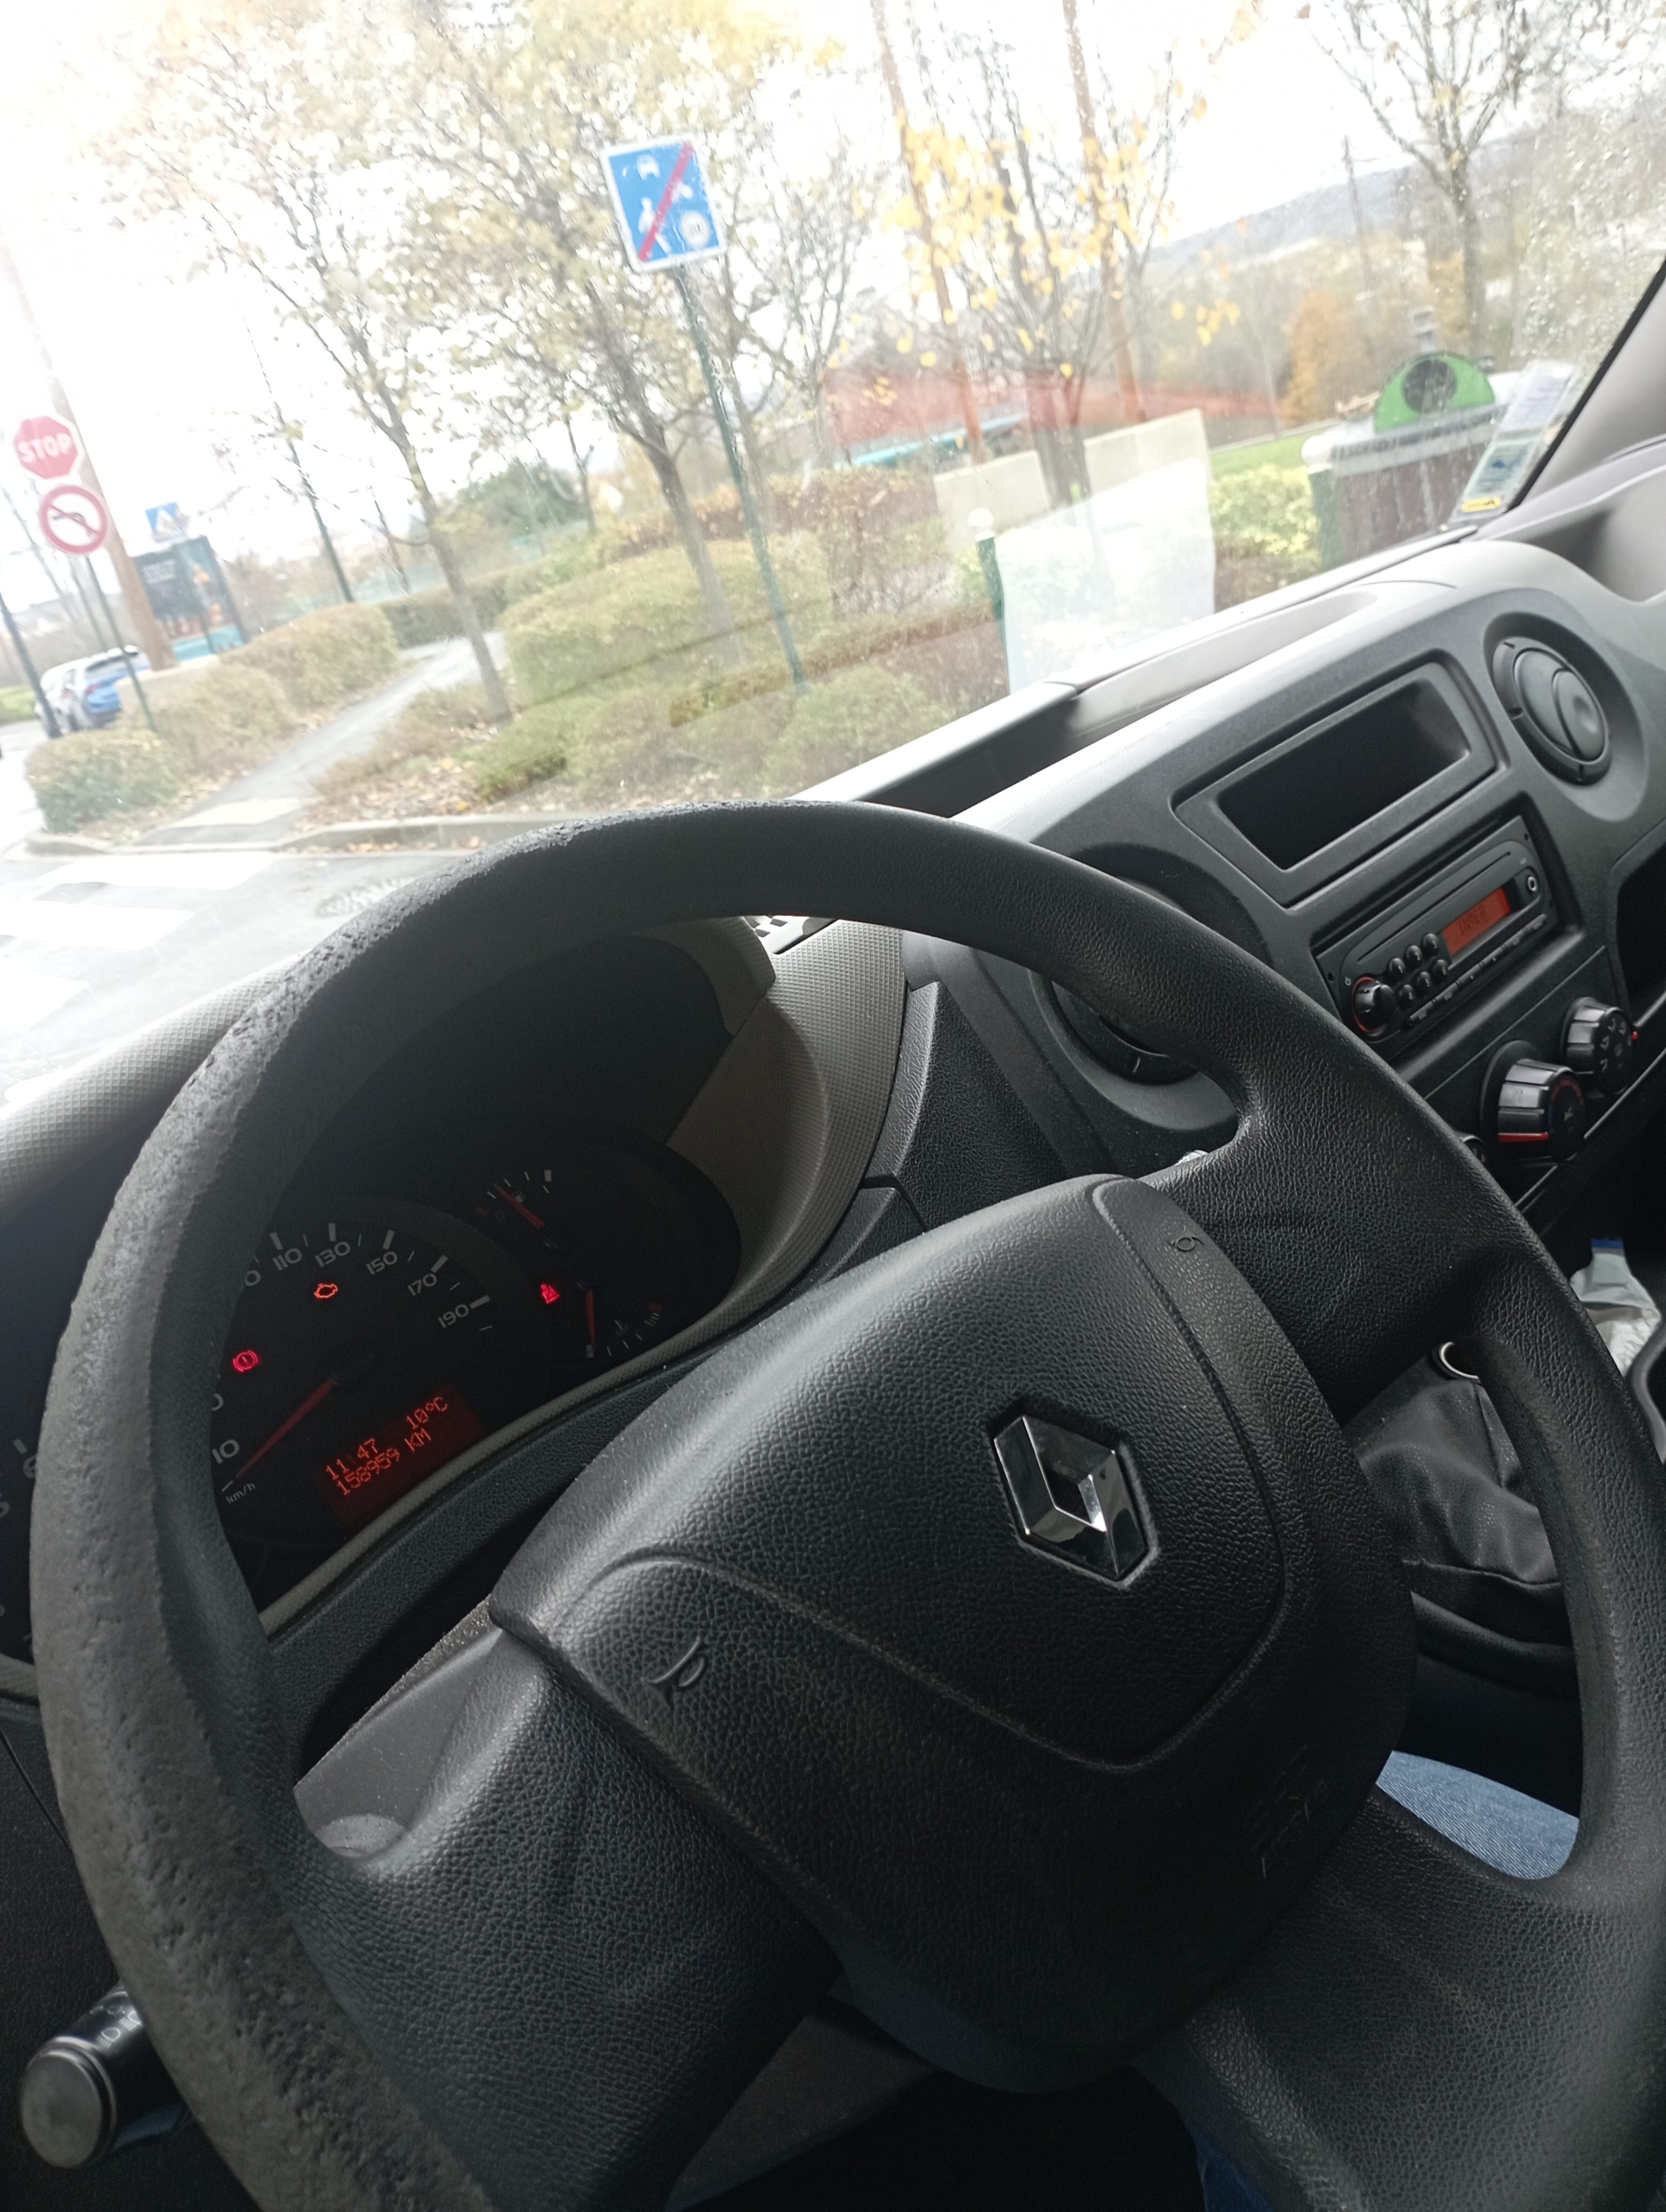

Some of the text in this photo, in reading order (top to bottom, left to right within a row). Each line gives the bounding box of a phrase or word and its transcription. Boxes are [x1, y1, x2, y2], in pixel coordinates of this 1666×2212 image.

[17, 432, 73, 462] STOP
[272, 1248, 303, 1271] 110
[315, 1241, 351, 1268] 130
[366, 1251, 398, 1275] 150
[244, 1270, 261, 1287] 0
[407, 1273, 437, 1296] 170
[438, 1304, 469, 1328] 190
[406, 1396, 448, 1430] 10°C
[211, 1439, 240, 1464] 10
[337, 1427, 432, 1496] 158959 KM
[226, 1483, 255, 1504] km/h
